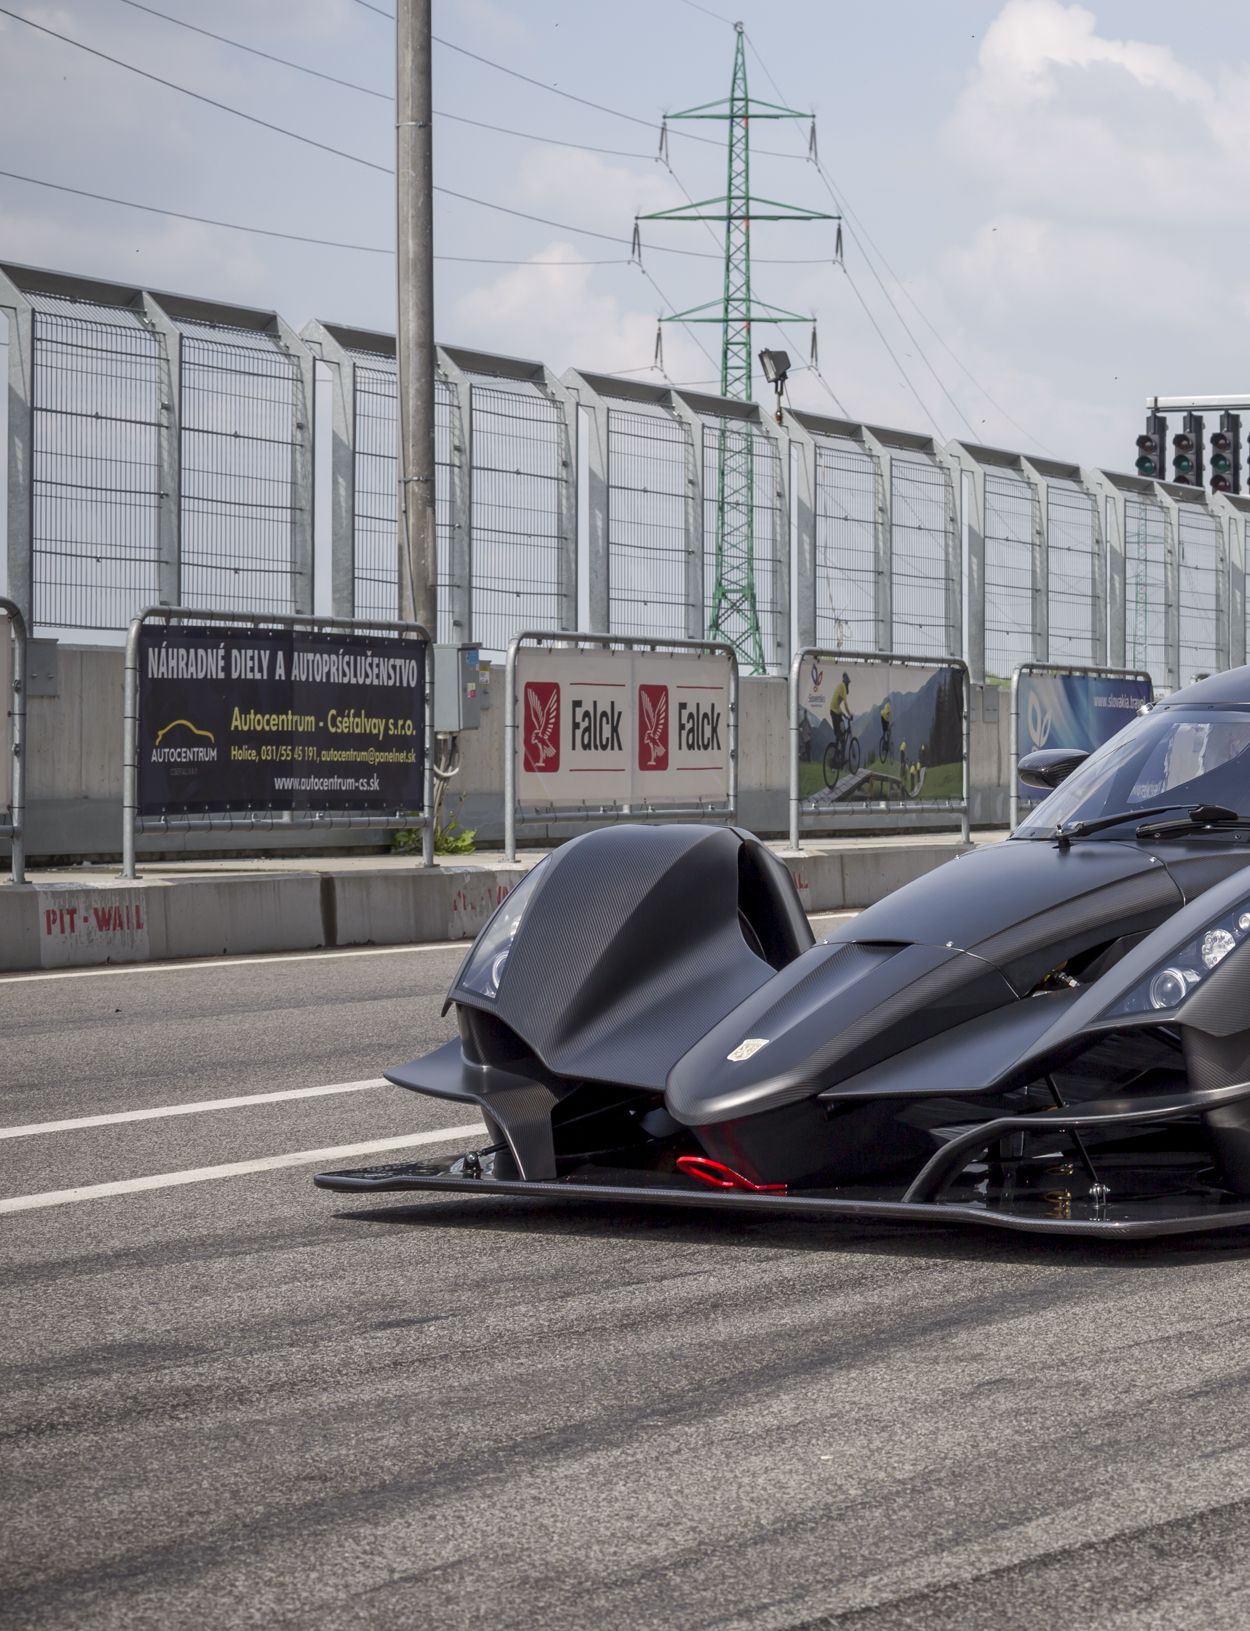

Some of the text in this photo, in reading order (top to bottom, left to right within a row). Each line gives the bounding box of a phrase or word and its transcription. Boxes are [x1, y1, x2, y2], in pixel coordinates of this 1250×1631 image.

[148, 643, 417, 687] NÁHRADNÉ DIELY A AUTOPRÍSLUŠENSTVO
[231, 706, 315, 731] Autocentrum
[327, 709, 386, 740] Cséfalvay
[388, 718, 416, 735] s.r.o.
[572, 700, 623, 751] Falck
[678, 702, 721, 751] Falck
[151, 747, 217, 762] AUTOCENTRUM
[231, 746, 259, 762] Holice,
[261, 746, 292, 761] 031/55
[294, 746, 302, 760] 45
[321, 747, 416, 765] autocentrum@panelnet.sk
[274, 773, 379, 790] www.autocentrum-cs.sk
[46, 908, 77, 935] PIT
